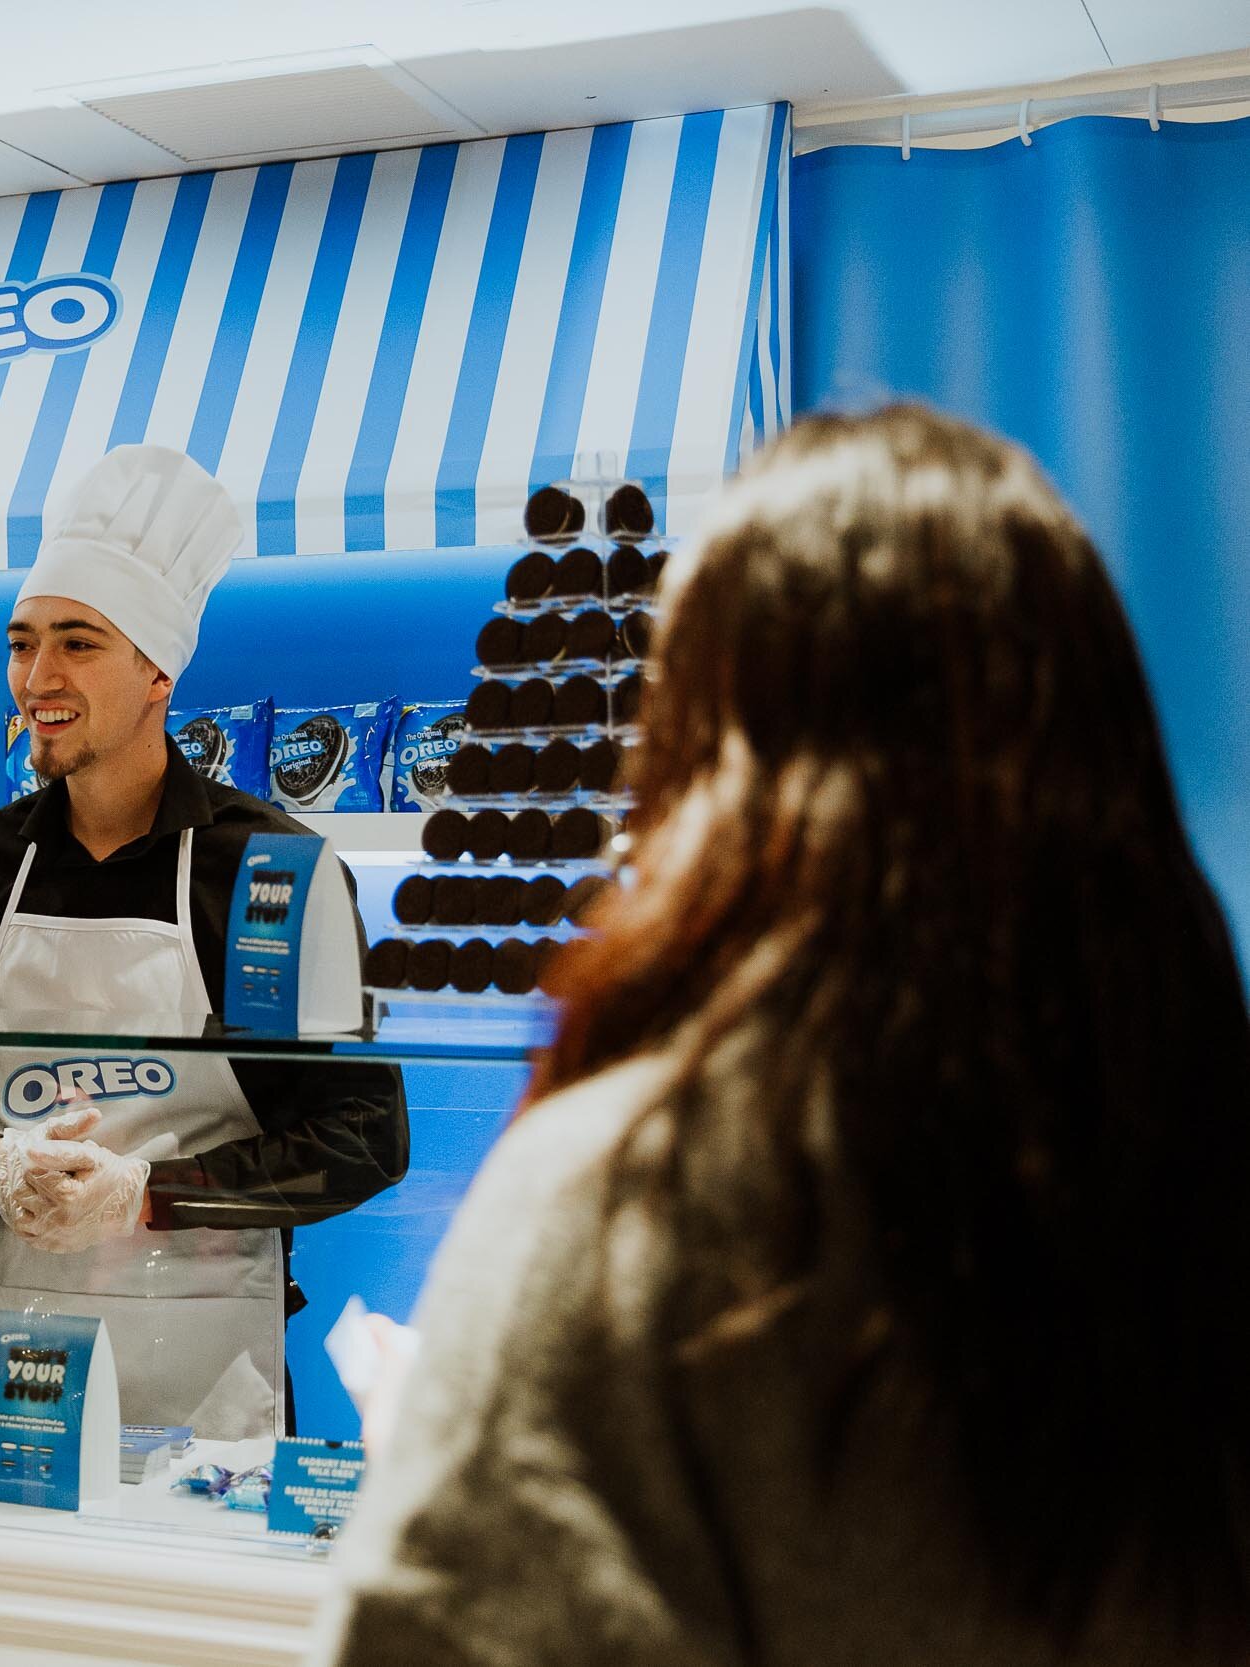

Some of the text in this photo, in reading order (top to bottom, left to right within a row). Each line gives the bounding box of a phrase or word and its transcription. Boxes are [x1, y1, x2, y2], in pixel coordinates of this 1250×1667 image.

[281, 731, 308, 741] Original
[406, 729, 442, 742] The Original
[399, 739, 457, 765] OREO
[281, 757, 312, 773] L'original
[249, 882, 293, 904] YOUR
[8, 1062, 171, 1114] OREO
[7, 1360, 66, 1384] YOUR
[297, 1457, 340, 1468] CADBURY
[294, 1496, 336, 1507] CADBURY
